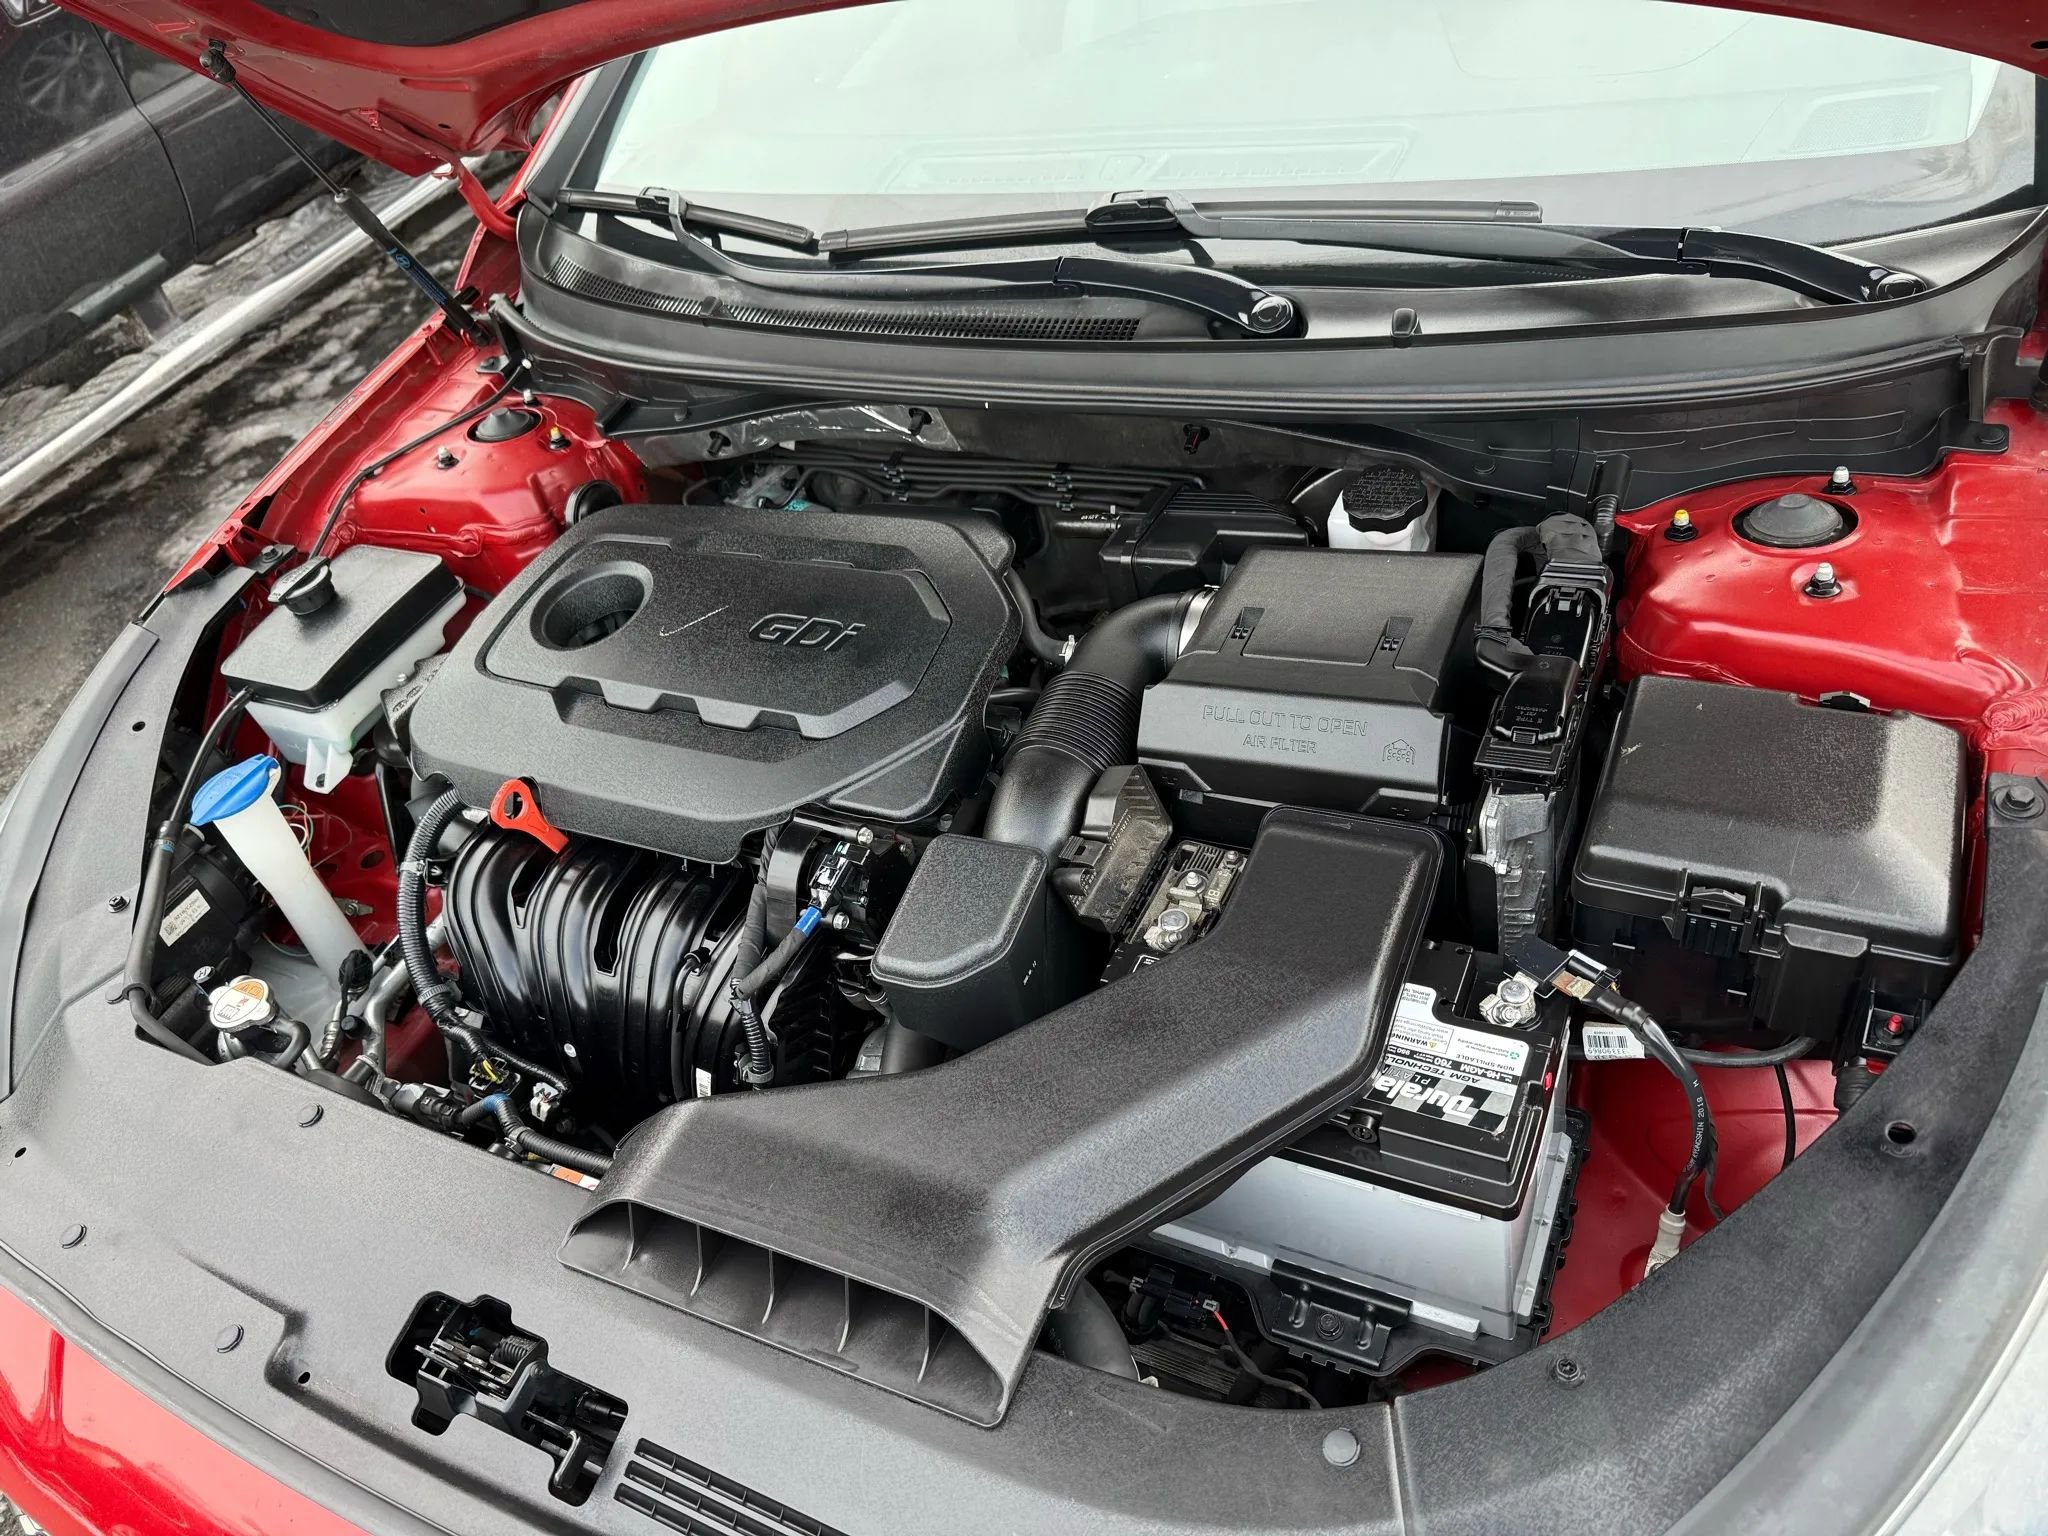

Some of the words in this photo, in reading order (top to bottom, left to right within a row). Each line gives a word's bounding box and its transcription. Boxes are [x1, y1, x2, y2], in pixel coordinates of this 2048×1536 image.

[1202, 704, 1245, 724] PULL
[1249, 709, 1286, 728] OUT
[1290, 712, 1314, 731] TO
[1317, 716, 1368, 737] OPEN
[1243, 734, 1267, 749] AIR
[1270, 735, 1317, 754] FILTER
[1433, 1057, 1453, 1069] 760
[1460, 1063, 1501, 1080] H6-AGM
[1450, 1072, 1481, 1084] AGM
[1374, 1075, 1475, 1119] Durala
